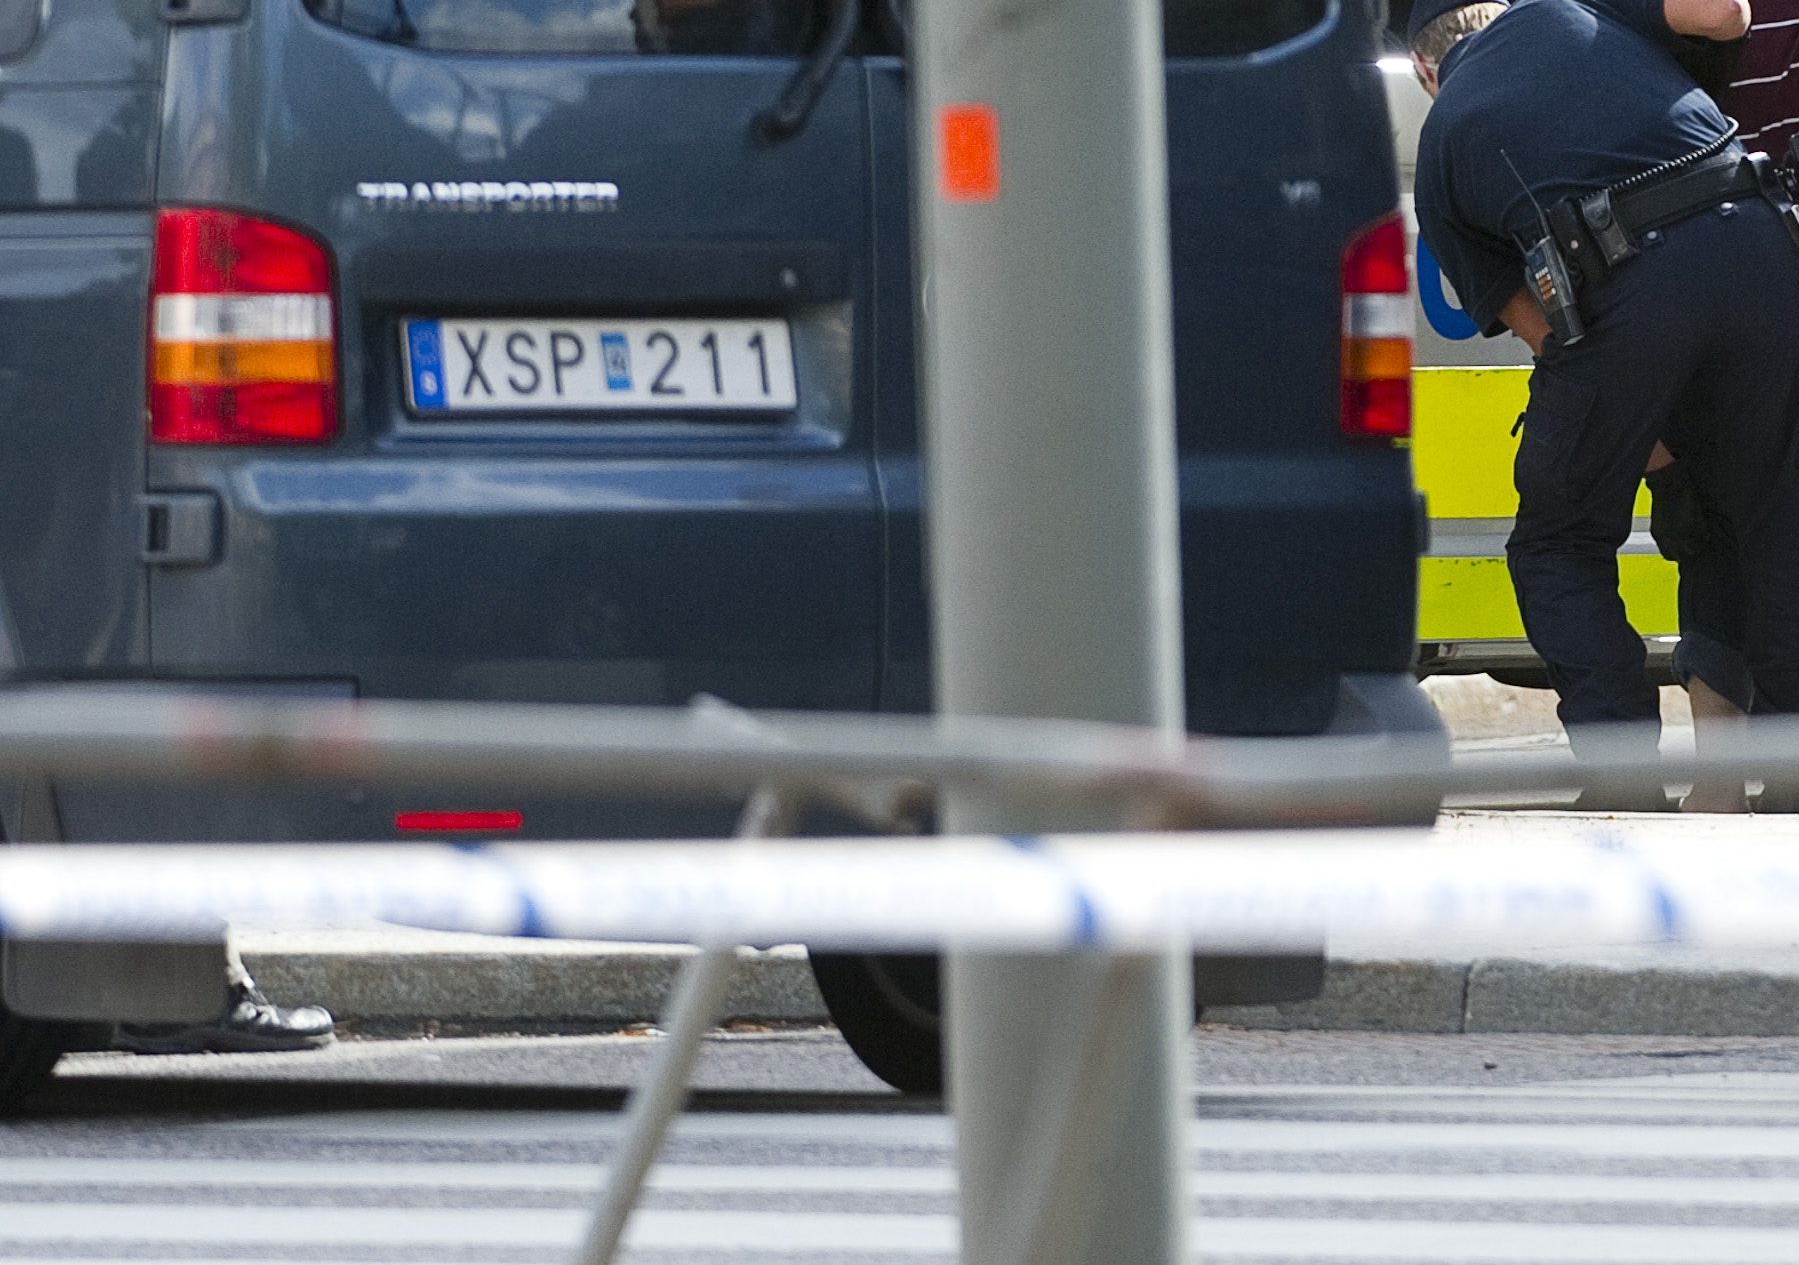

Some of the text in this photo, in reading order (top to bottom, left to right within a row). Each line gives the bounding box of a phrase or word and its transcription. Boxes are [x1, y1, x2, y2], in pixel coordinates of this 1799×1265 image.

[356, 181, 619, 212] TRANSPORTER
[456, 330, 587, 397] XSP
[645, 330, 773, 396] 211
